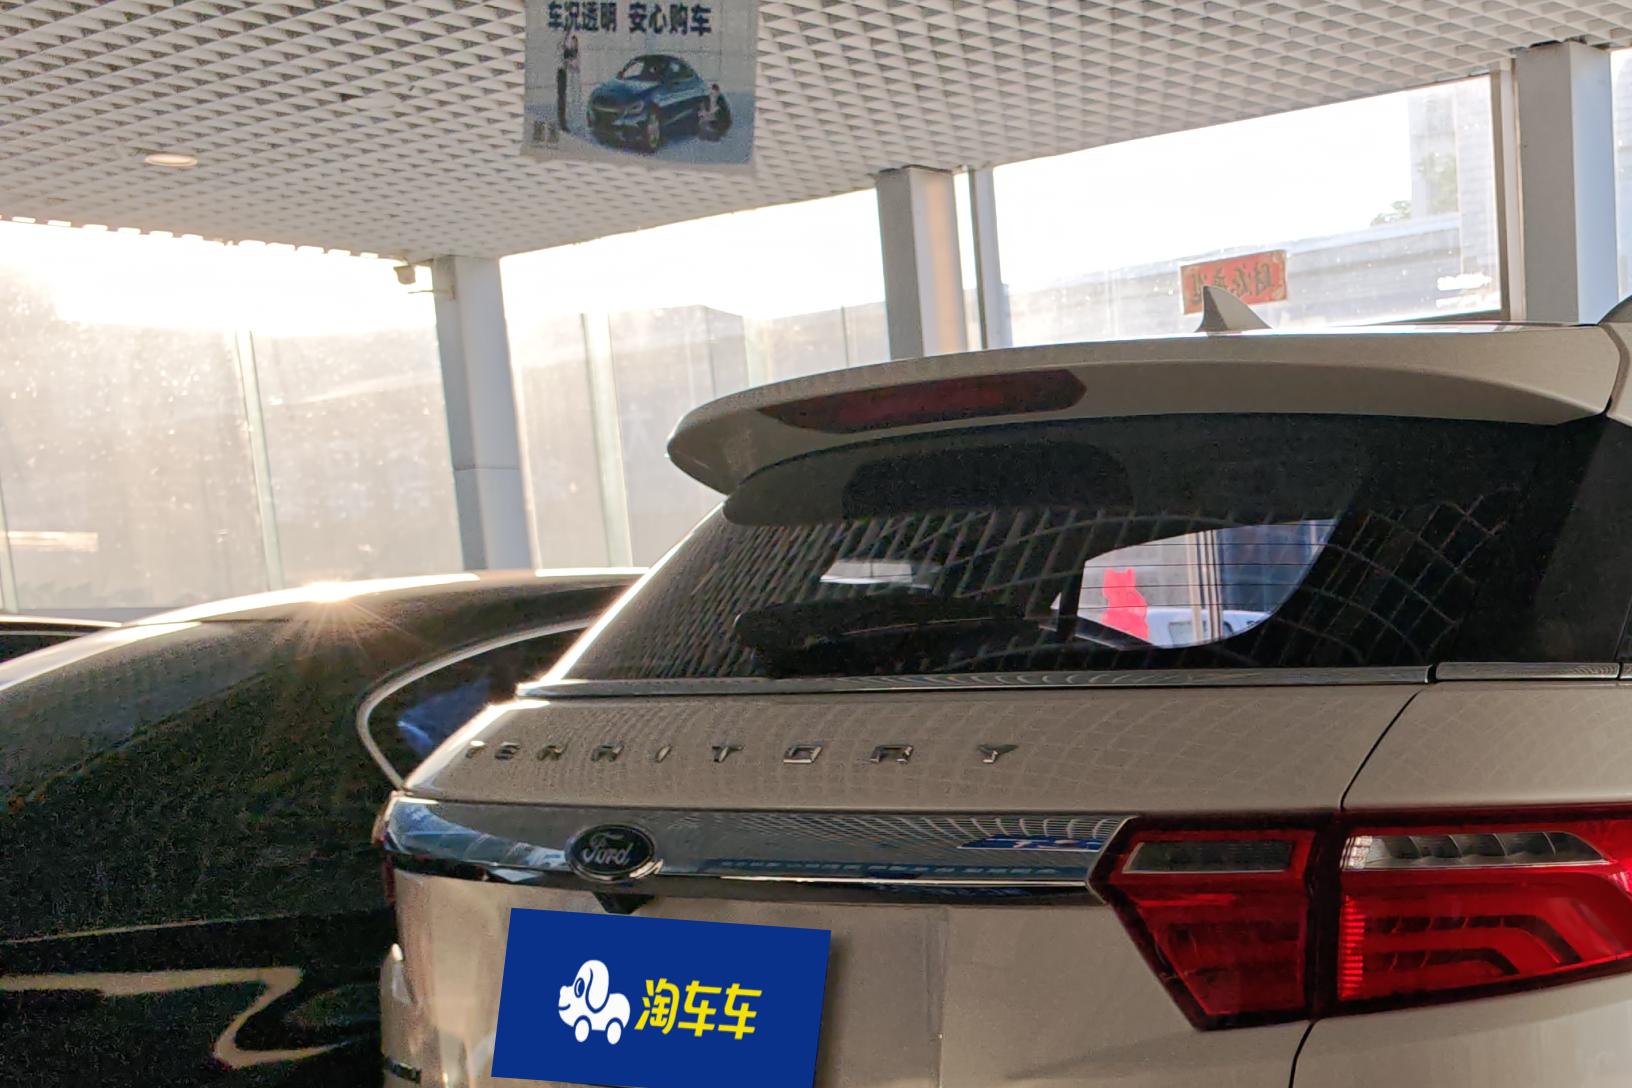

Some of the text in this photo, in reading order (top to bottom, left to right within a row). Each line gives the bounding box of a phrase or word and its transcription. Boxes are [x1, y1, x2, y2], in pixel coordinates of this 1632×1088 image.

[547, 2, 712, 35] 车况透明 安心购车
[579, 834, 634, 866] Ford
